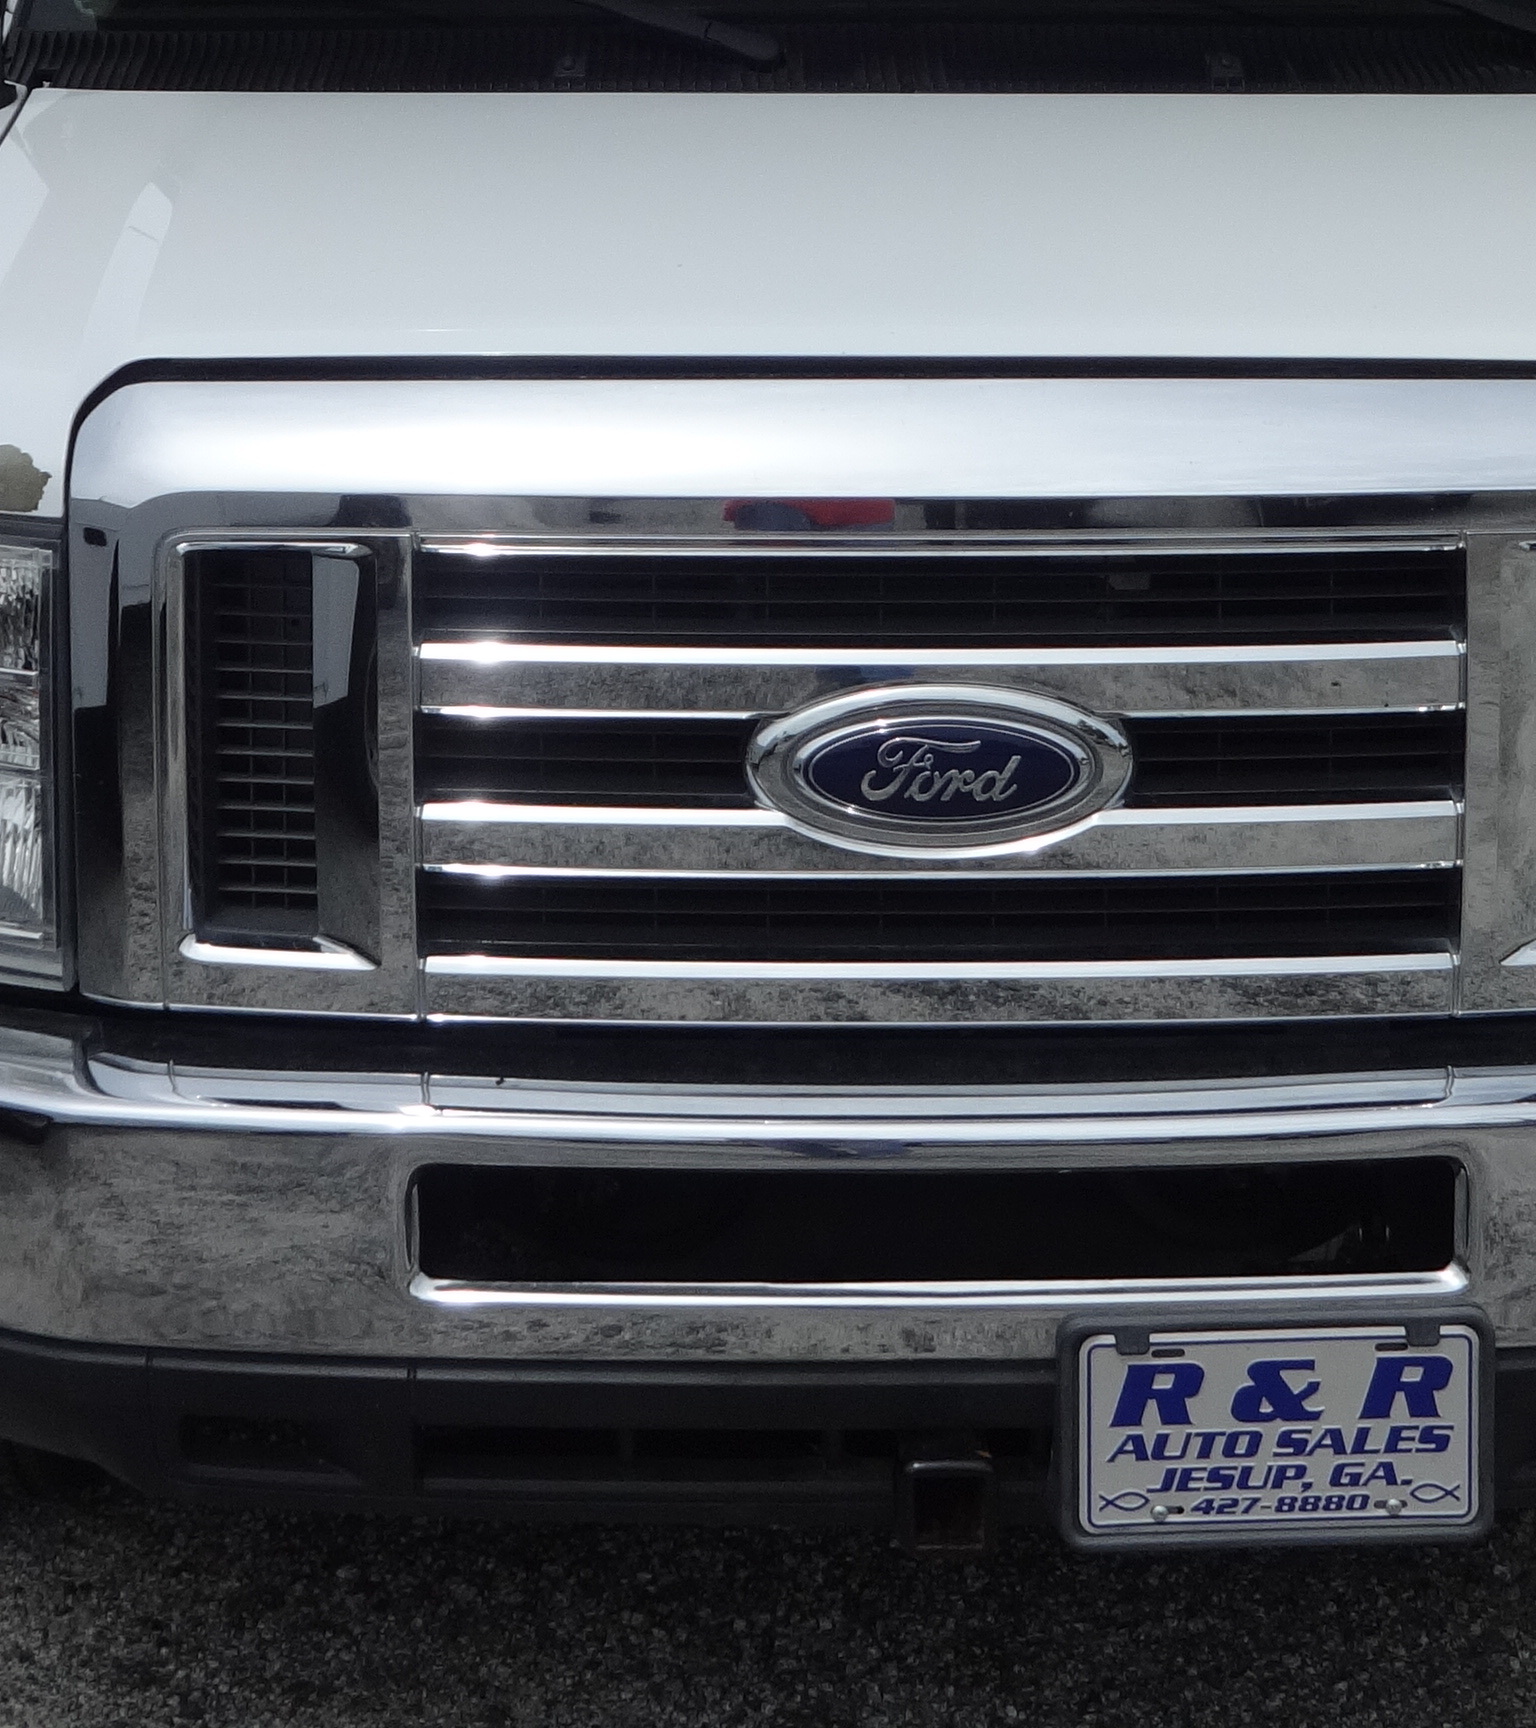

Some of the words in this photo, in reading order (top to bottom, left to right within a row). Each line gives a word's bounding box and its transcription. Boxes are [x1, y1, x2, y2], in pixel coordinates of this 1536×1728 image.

[861, 737, 1021, 802] Ford
[1110, 1362, 1205, 1427] R
[1230, 1359, 1326, 1422] &
[1358, 1355, 1453, 1419] R
[1106, 1430, 1263, 1463] AUTO
[1272, 1425, 1454, 1457] SALES
[1146, 1464, 1313, 1493] JESUP,
[1328, 1461, 1414, 1487] GA.
[1190, 1494, 1371, 1515] 427-8880
